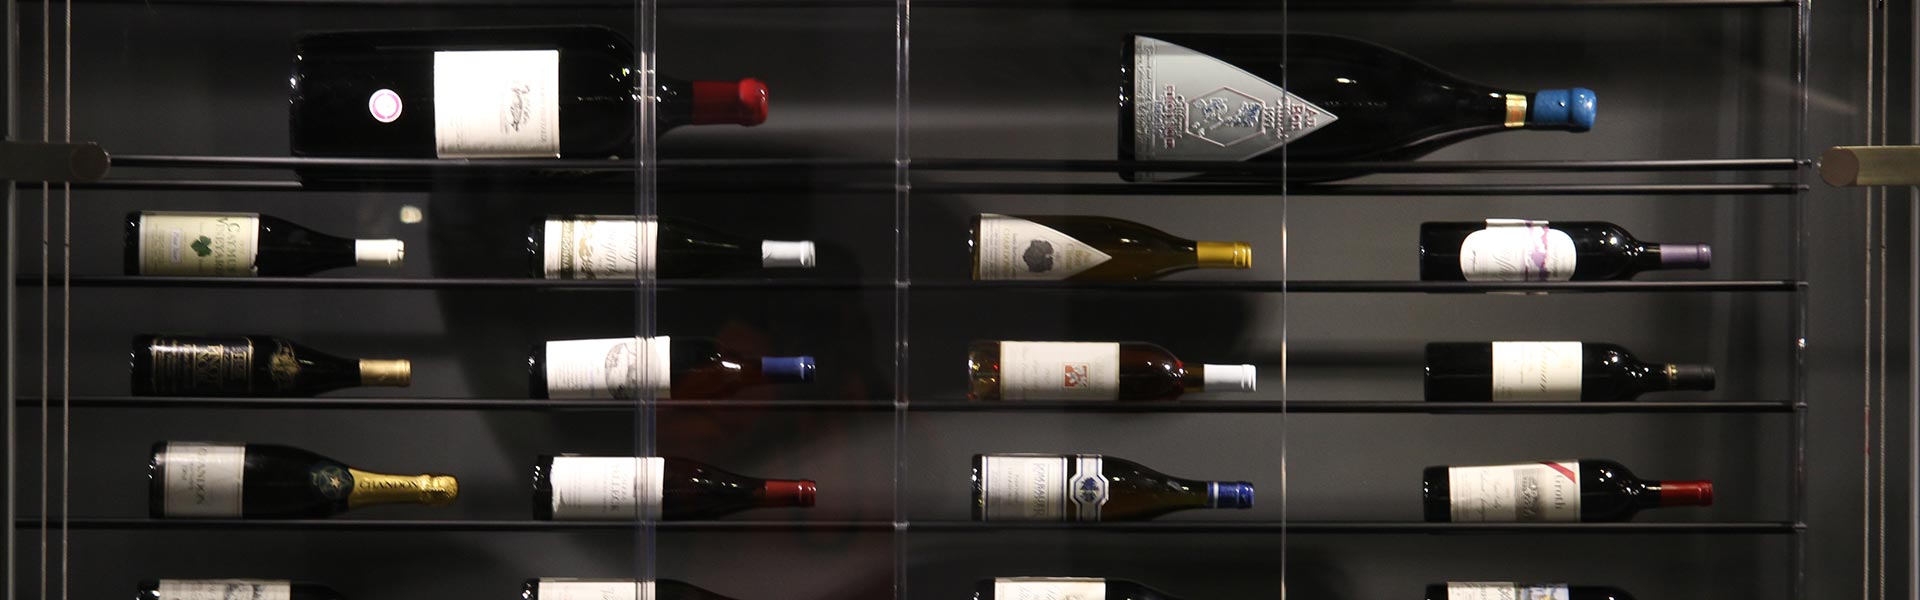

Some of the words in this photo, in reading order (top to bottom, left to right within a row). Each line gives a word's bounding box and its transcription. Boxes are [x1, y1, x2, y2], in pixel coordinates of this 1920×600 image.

[1291, 104, 1304, 131] Bon
[1304, 106, 1320, 129] Au
[197, 448, 208, 504] CANDON
[359, 480, 419, 489] CHANDON
[1554, 474, 1567, 511] Groth
